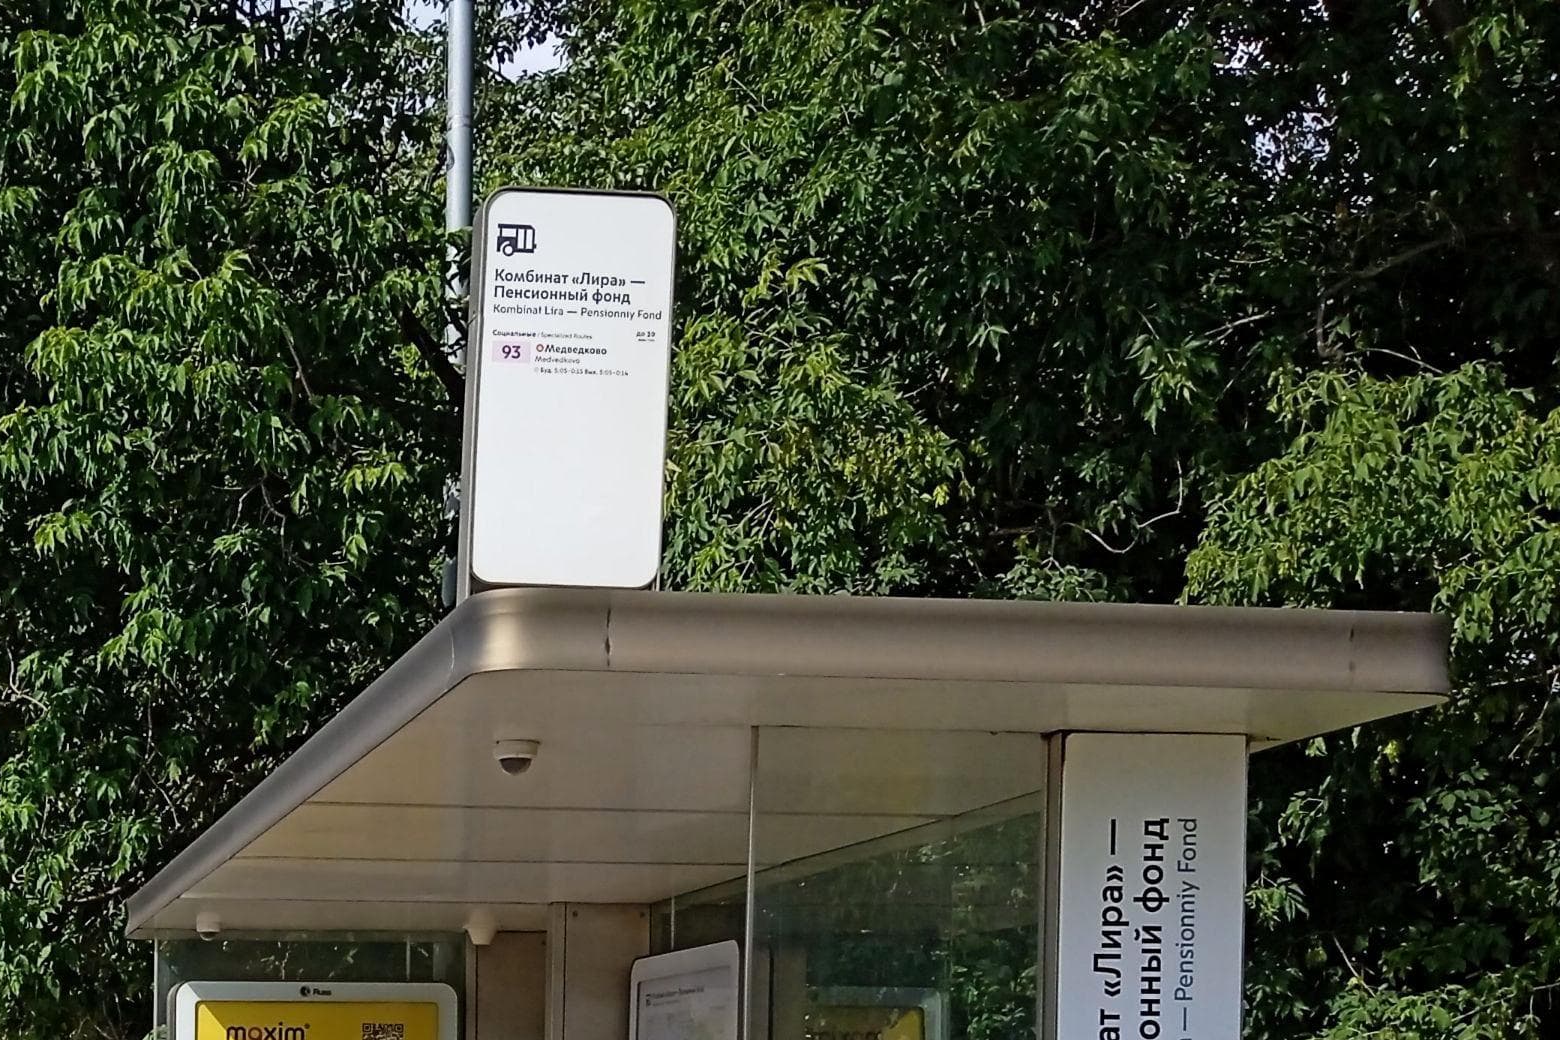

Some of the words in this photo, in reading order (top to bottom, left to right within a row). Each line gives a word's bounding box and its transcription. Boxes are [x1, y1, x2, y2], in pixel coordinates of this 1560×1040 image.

[494, 268, 569, 284] Комбинат
[571, 272, 626, 289] «Лира»
[493, 285, 588, 301] Пенсионный
[592, 288, 631, 305] фонд
[493, 303, 542, 315] Kombinat
[544, 305, 564, 316] Lira
[580, 307, 635, 320] Pensionniy
[637, 309, 662, 320] Fond
[501, 344, 522, 360] 93
[544, 344, 608, 355] Медведково
[1177, 818, 1198, 873] Fond
[1133, 817, 1170, 913] фонд
[1093, 865, 1130, 997] «Лира»
[1174, 880, 1200, 1001] Pensionniy
